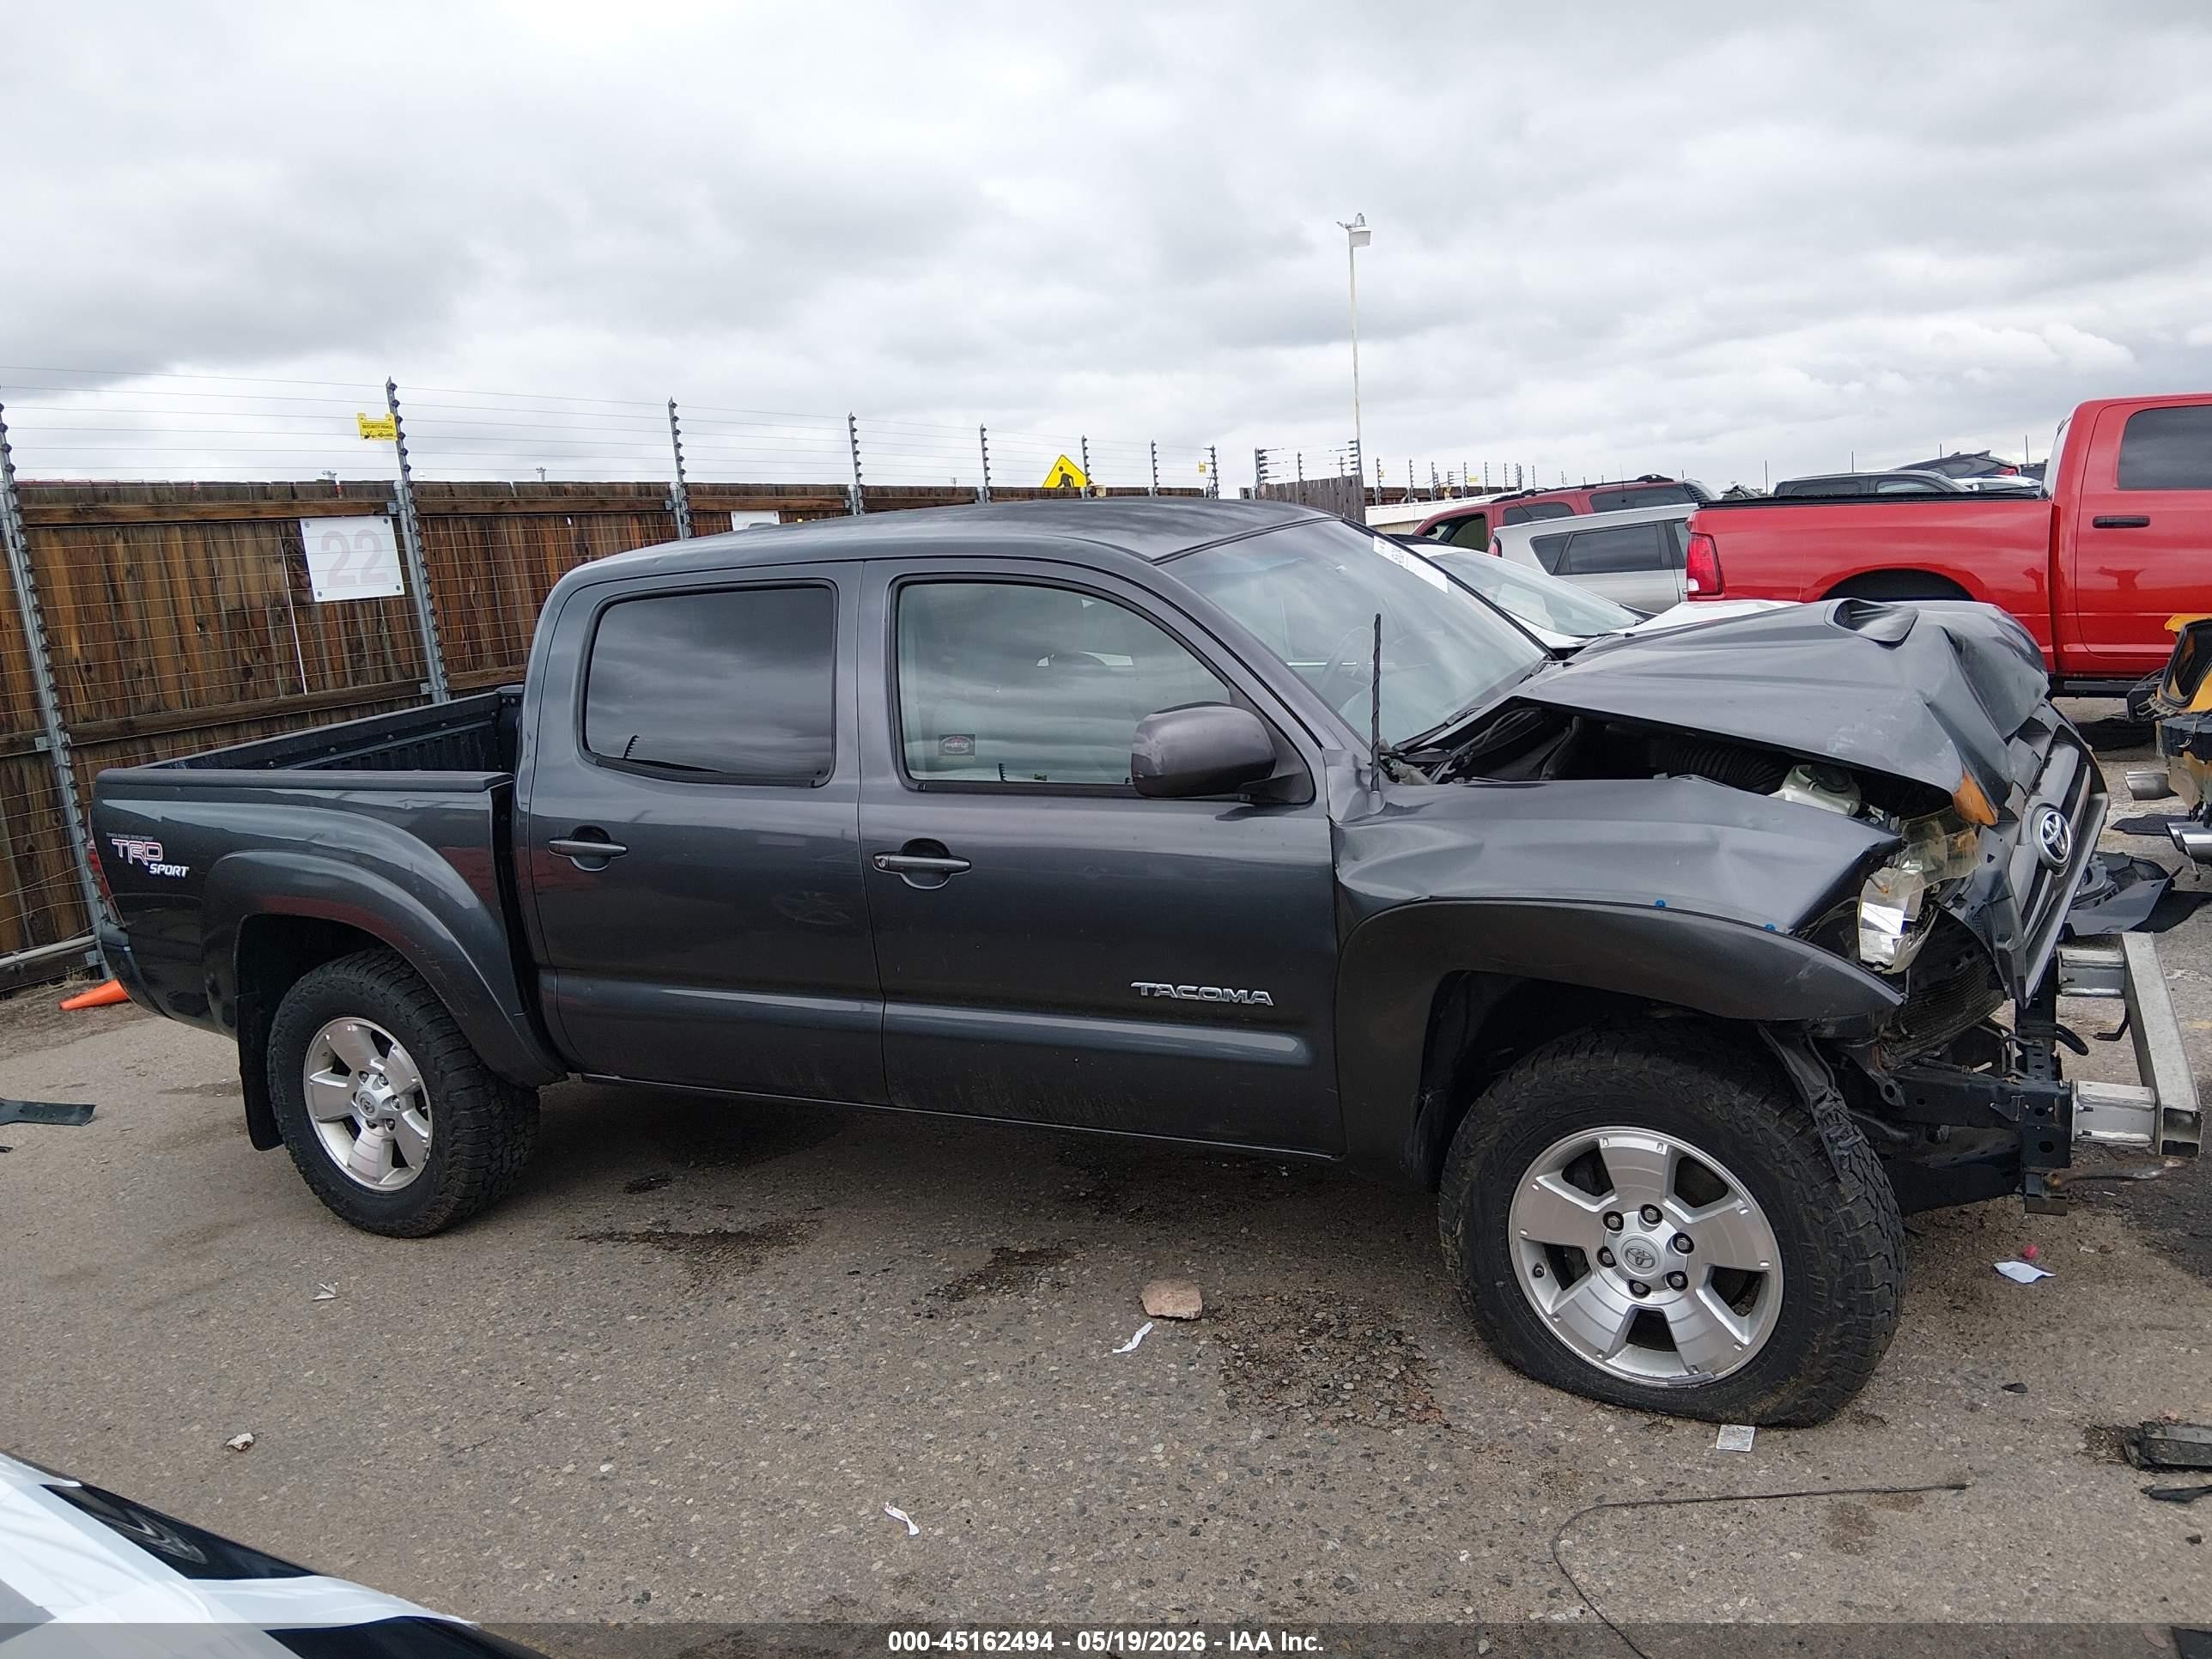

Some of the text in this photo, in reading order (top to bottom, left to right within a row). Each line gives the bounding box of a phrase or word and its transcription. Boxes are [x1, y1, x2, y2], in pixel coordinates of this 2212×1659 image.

[320, 529, 389, 586] 22
[112, 838, 163, 866] TRD
[149, 863, 190, 878] SPORT
[1130, 981, 1274, 1006] TACOMA
